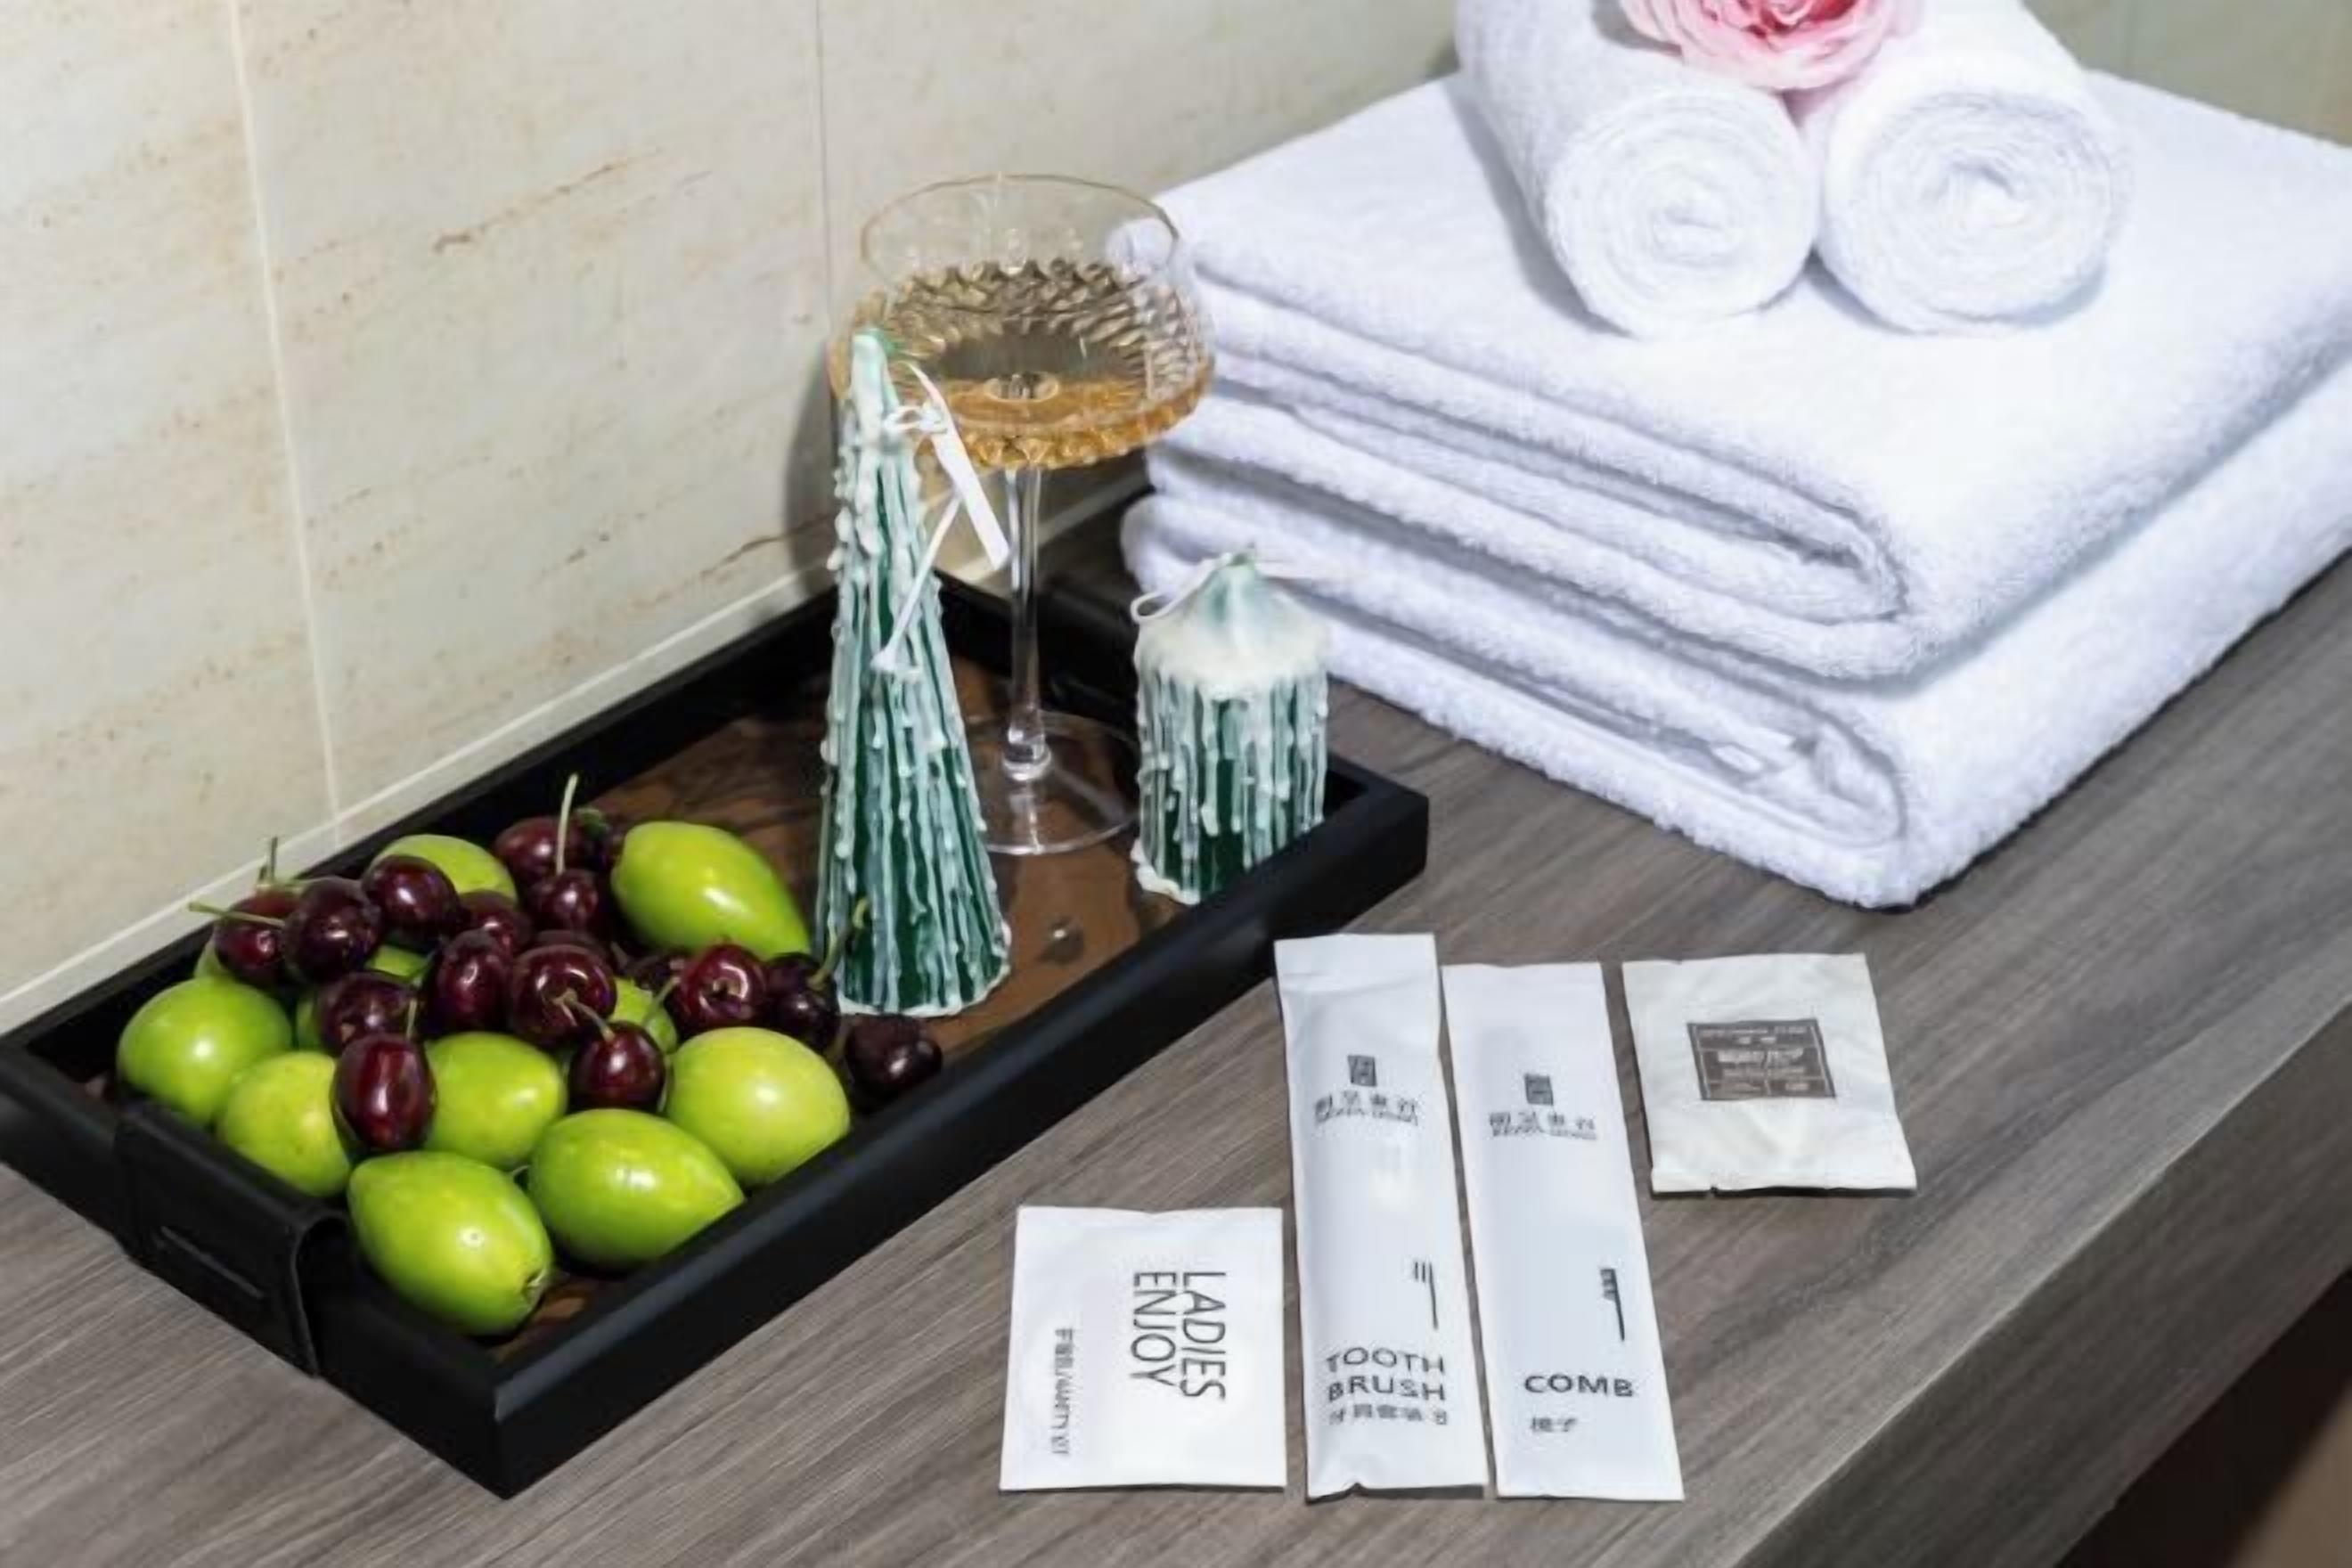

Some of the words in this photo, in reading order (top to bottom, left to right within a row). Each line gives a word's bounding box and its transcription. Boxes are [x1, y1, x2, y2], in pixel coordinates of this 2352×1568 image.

[1130, 1271, 1177, 1388] ENJOY
[1180, 1271, 1227, 1401] LADIES
[1326, 1345, 1445, 1374] TOOTH
[1327, 1375, 1447, 1402] BRUSH
[1523, 1373, 1634, 1397] COMB
